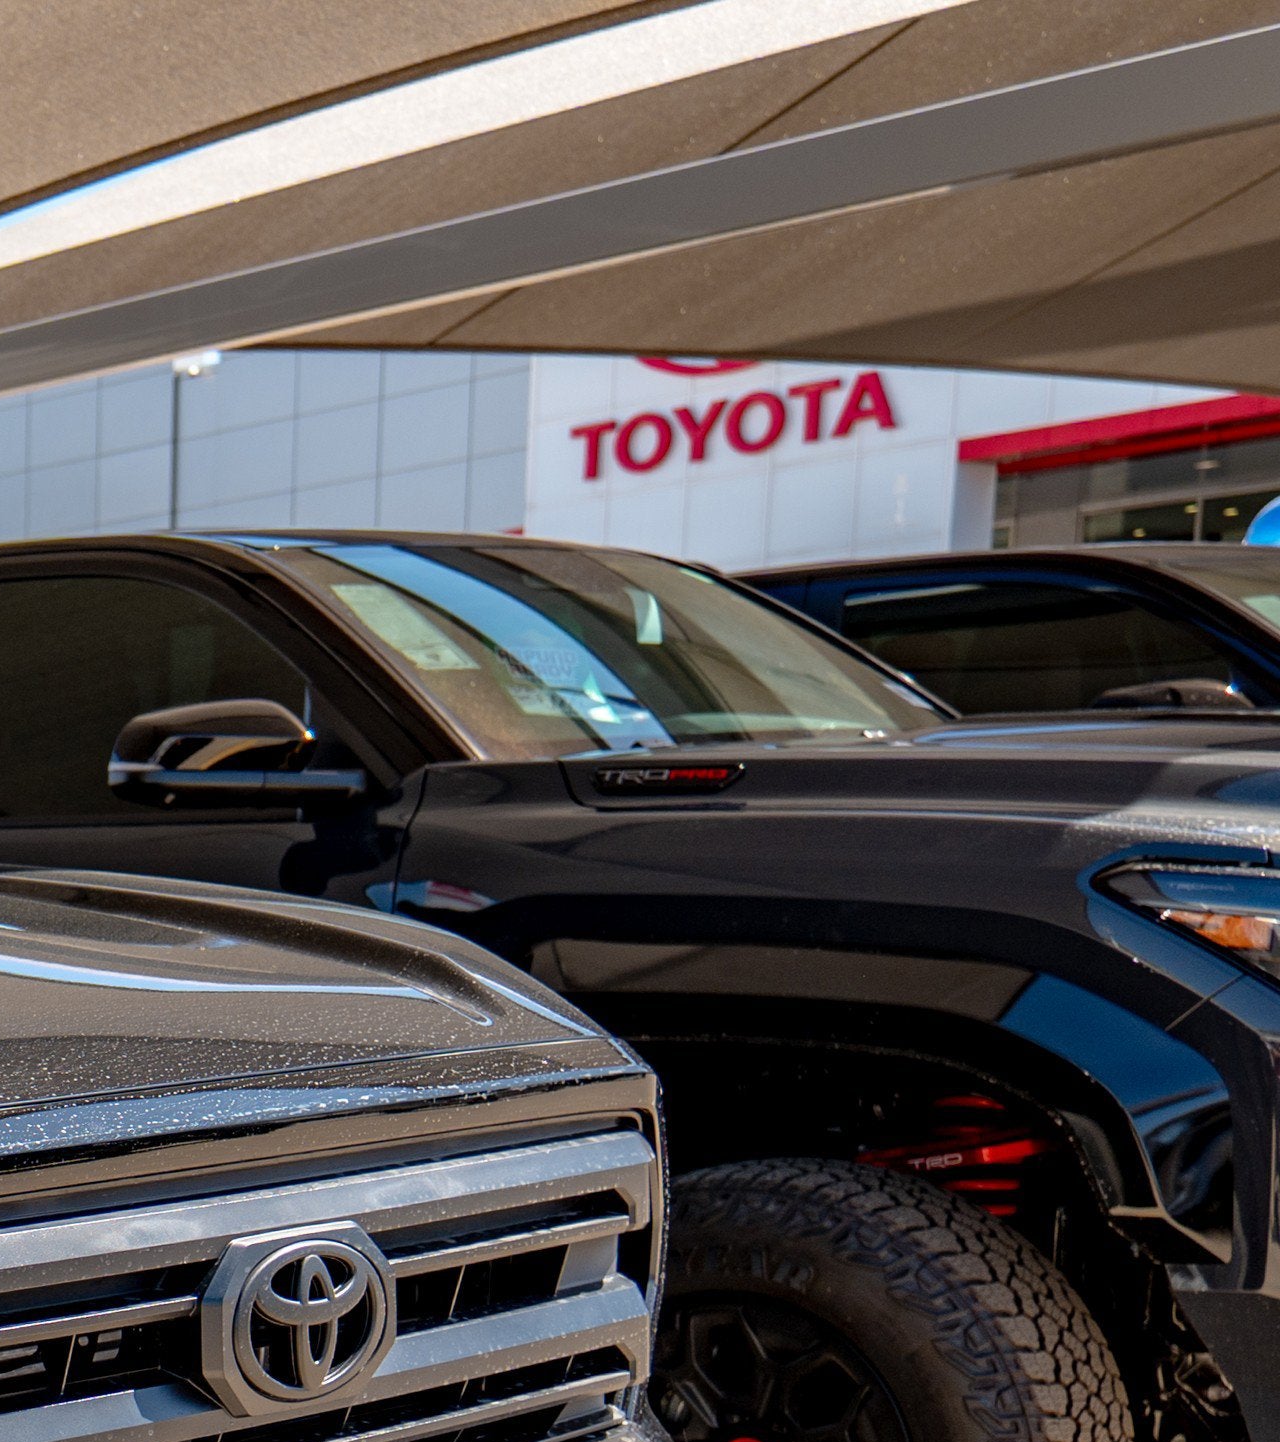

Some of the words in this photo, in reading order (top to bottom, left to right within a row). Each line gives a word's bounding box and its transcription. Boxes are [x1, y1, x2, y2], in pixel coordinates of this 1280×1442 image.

[571, 370, 897, 480] TOYOTA
[597, 769, 670, 785] TRD
[670, 768, 729, 780] PRO
[908, 1153, 962, 1170] TRD
